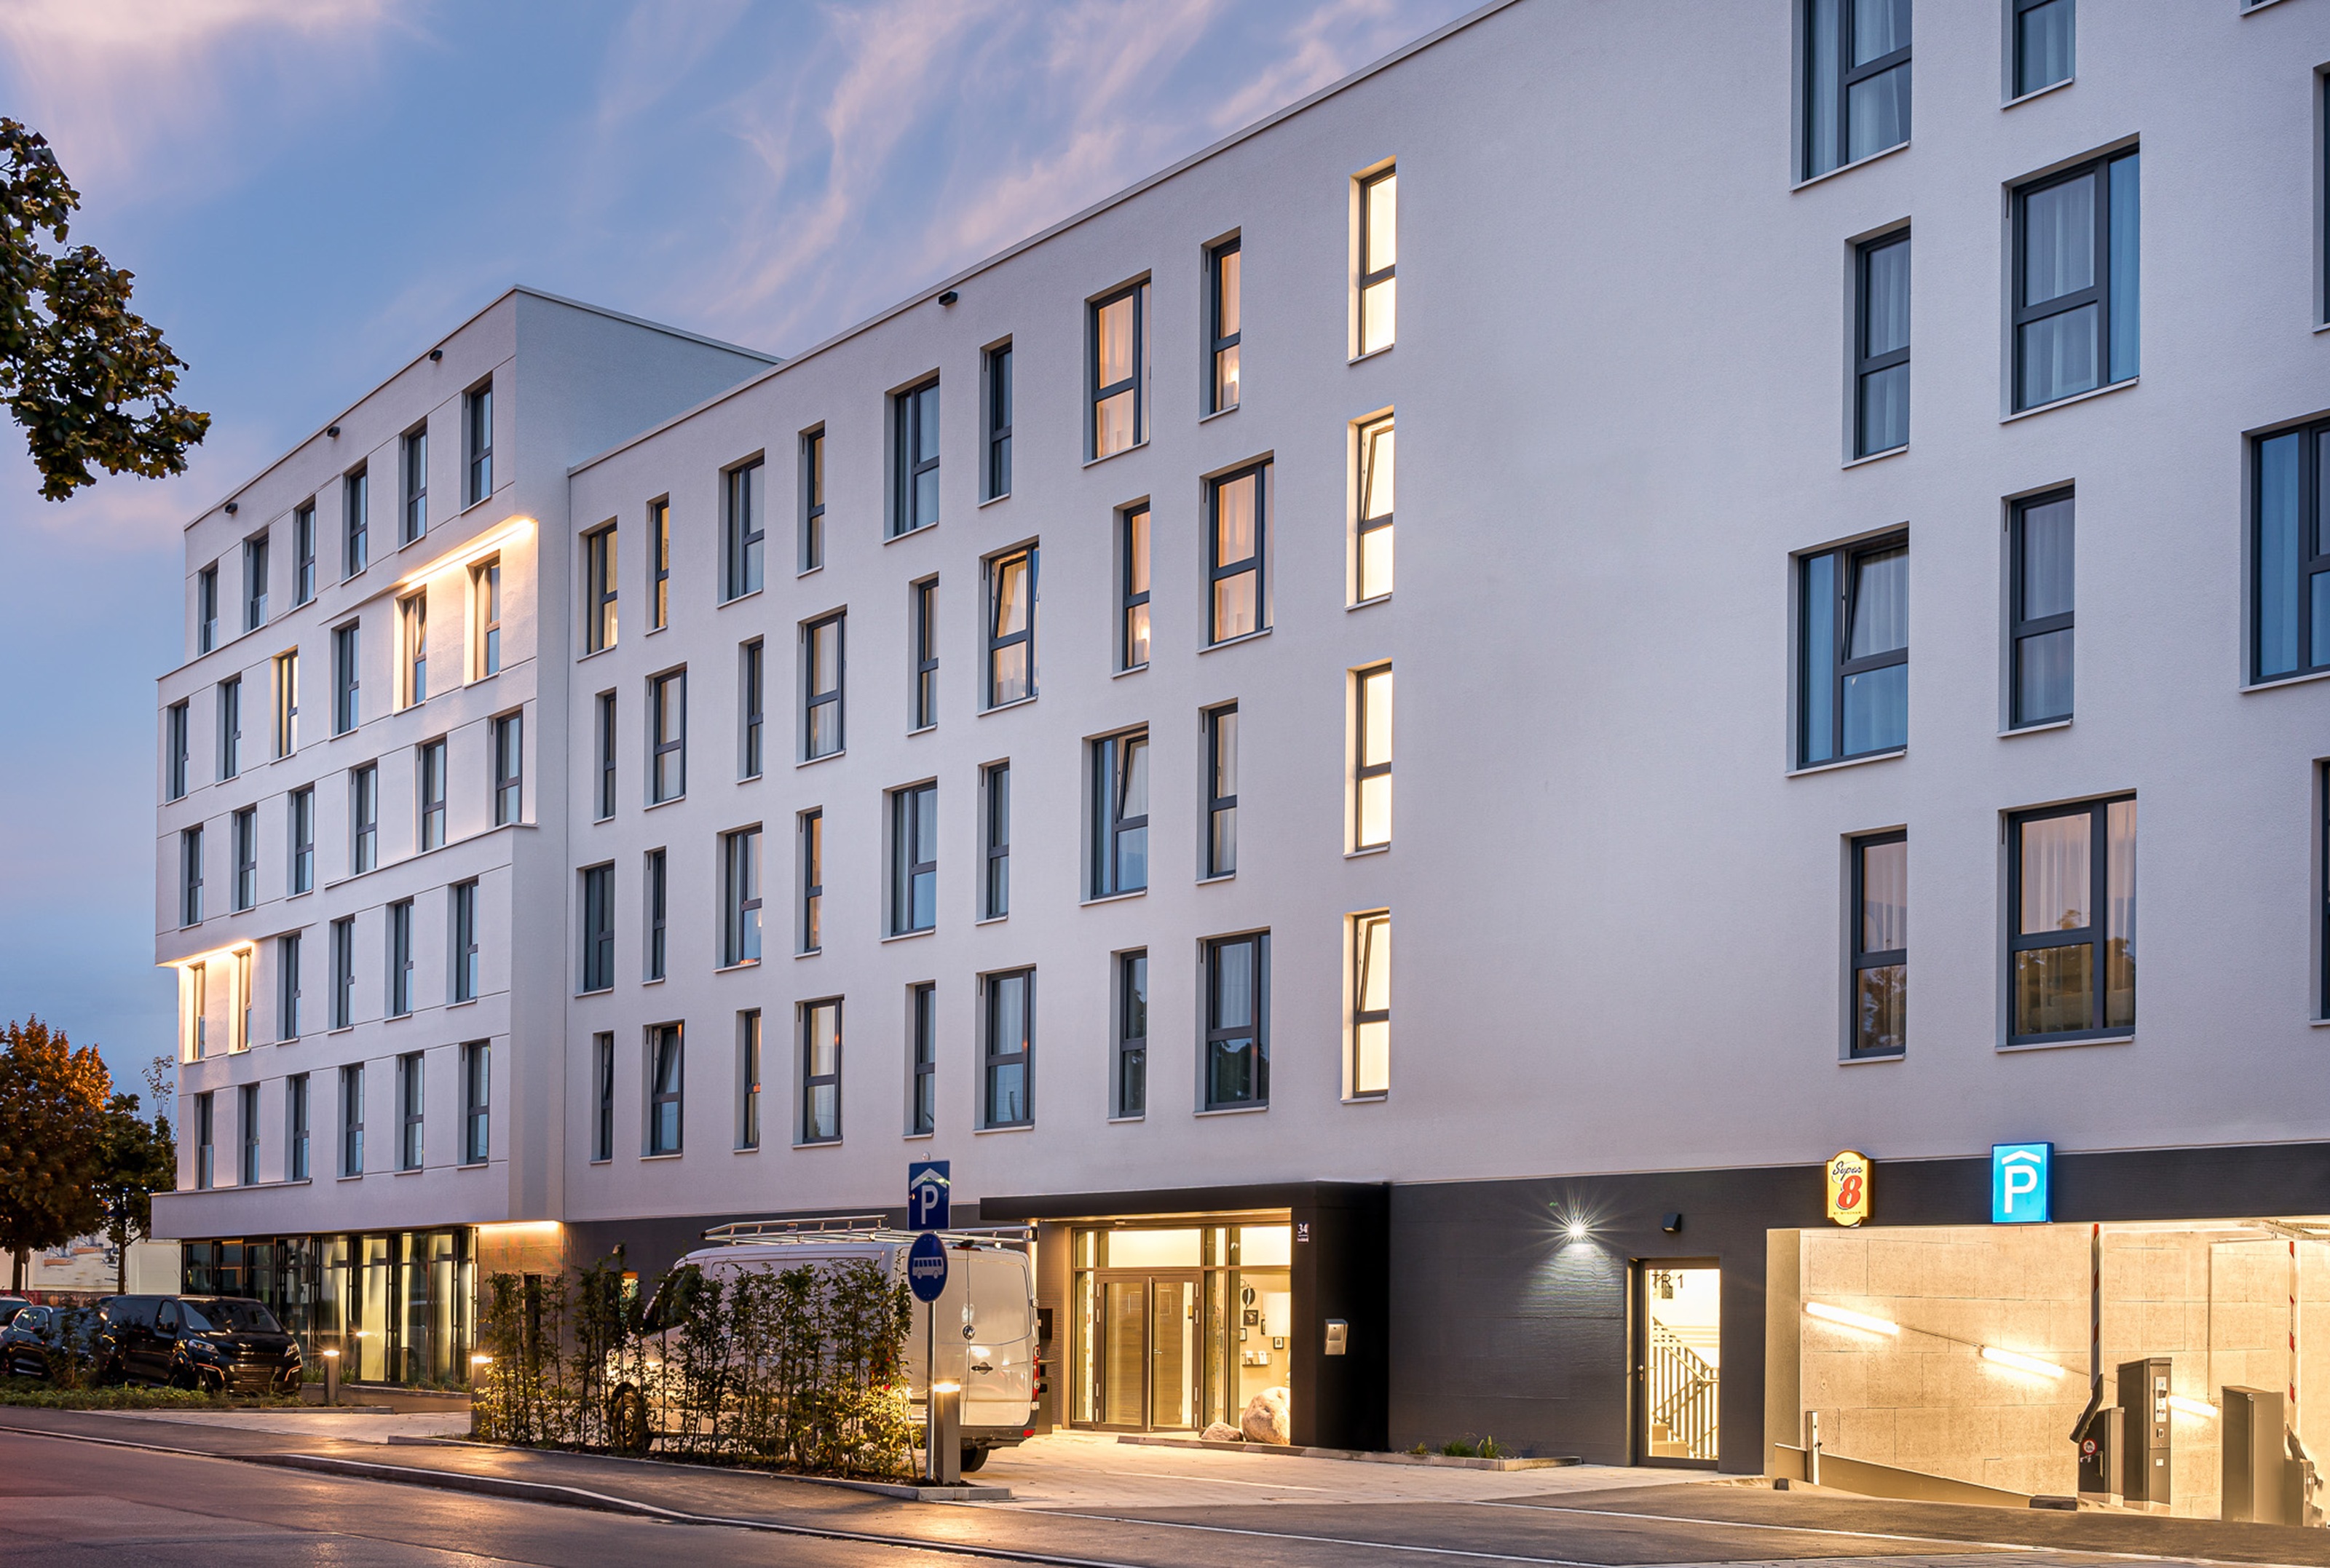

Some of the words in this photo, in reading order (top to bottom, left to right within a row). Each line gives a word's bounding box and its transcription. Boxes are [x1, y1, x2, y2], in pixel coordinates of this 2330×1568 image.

[1832, 1160, 1863, 1181] Super
[921, 1185, 939, 1224] P
[1836, 1175, 1863, 1209] 8
[2004, 1165, 2037, 1213] P
[1651, 1274, 1672, 1288] TR
[1678, 1274, 1683, 1288] 1
